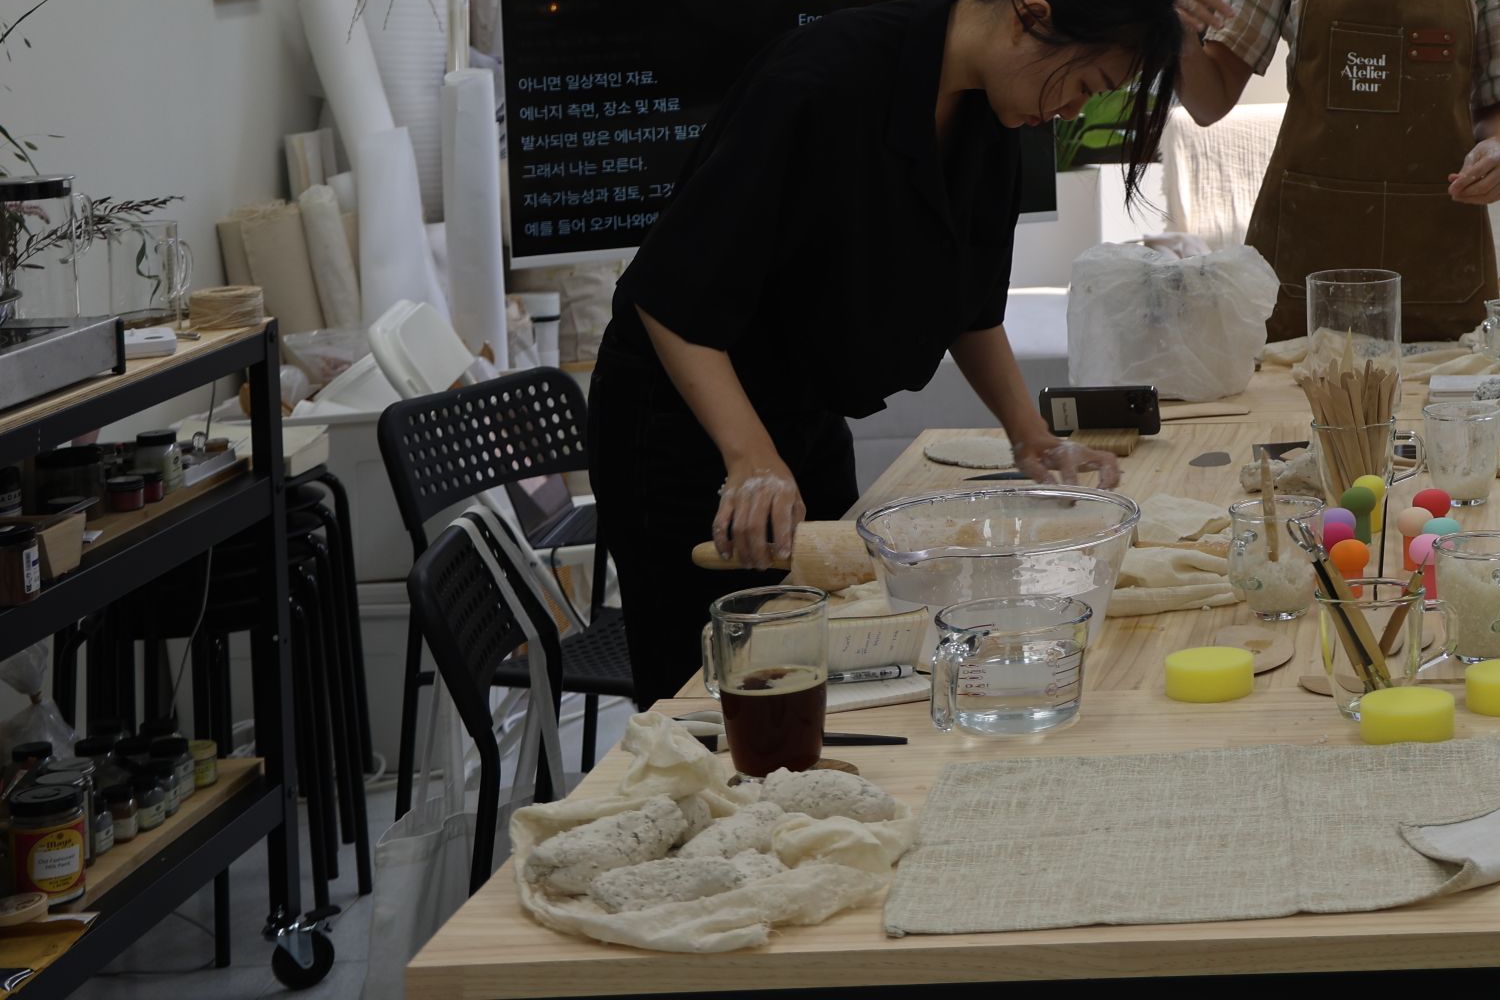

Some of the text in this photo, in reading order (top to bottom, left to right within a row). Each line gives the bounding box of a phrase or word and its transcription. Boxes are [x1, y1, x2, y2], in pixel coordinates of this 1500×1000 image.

[1346, 51, 1386, 66] Seoul
[519, 71, 657, 92] 아니면 일상적인 자료.
[1341, 66, 1389, 80] Atelier
[1349, 79, 1381, 92] Tour
[520, 98, 680, 120] 에너지 측면, 장소 및 재료
[521, 124, 706, 151] 발사되면 많은 에너지가 필요
[523, 156, 647, 178] 그래서 나는 모른다.
[524, 188, 609, 207] 지속가능성과
[613, 186, 644, 201] 점토,
[525, 221, 553, 236] 예를
[558, 218, 585, 235] 들어
